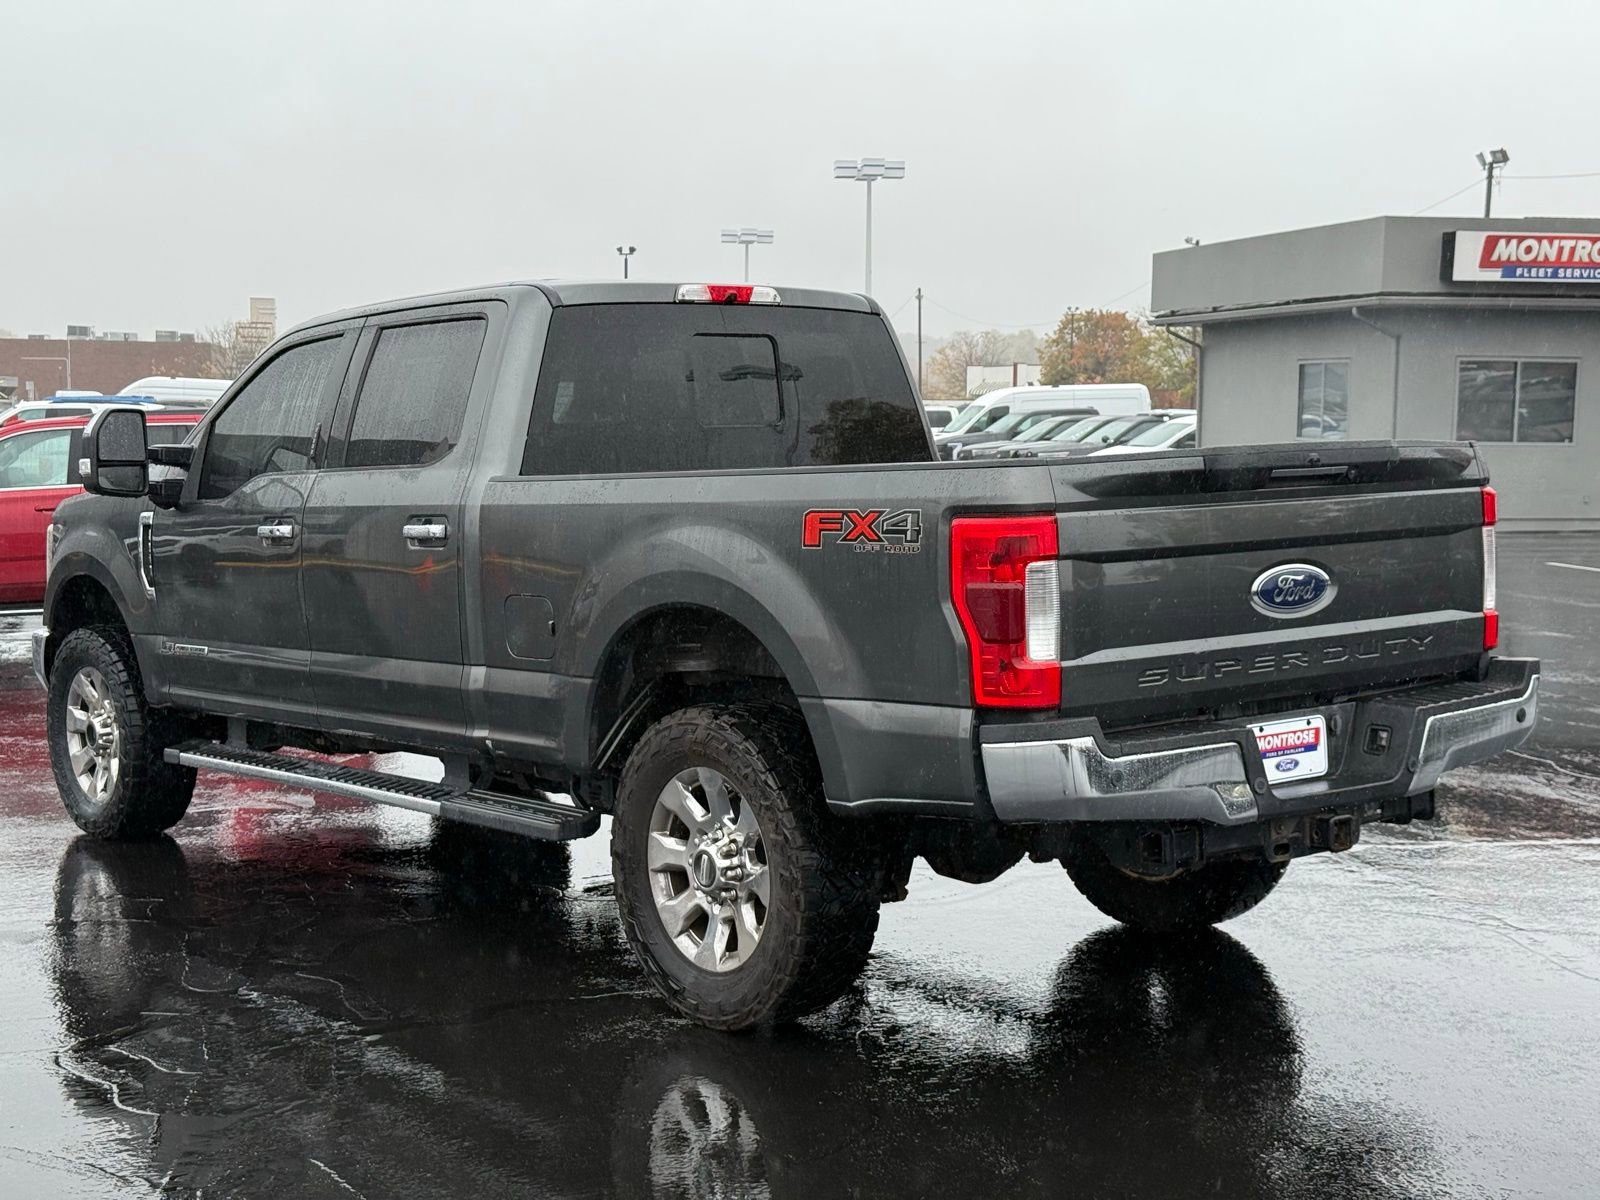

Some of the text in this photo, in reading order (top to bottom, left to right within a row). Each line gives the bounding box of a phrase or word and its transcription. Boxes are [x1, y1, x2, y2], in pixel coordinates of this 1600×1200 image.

[1516, 267, 1554, 277] FLEET
[802, 508, 922, 549] FX4
[853, 544, 920, 554] OFF ROAD
[1273, 574, 1316, 602] Ford
[1137, 635, 1434, 687] SUPER DUTY
[1256, 728, 1316, 751] MONTROSE
[1278, 759, 1296, 770] Ford
